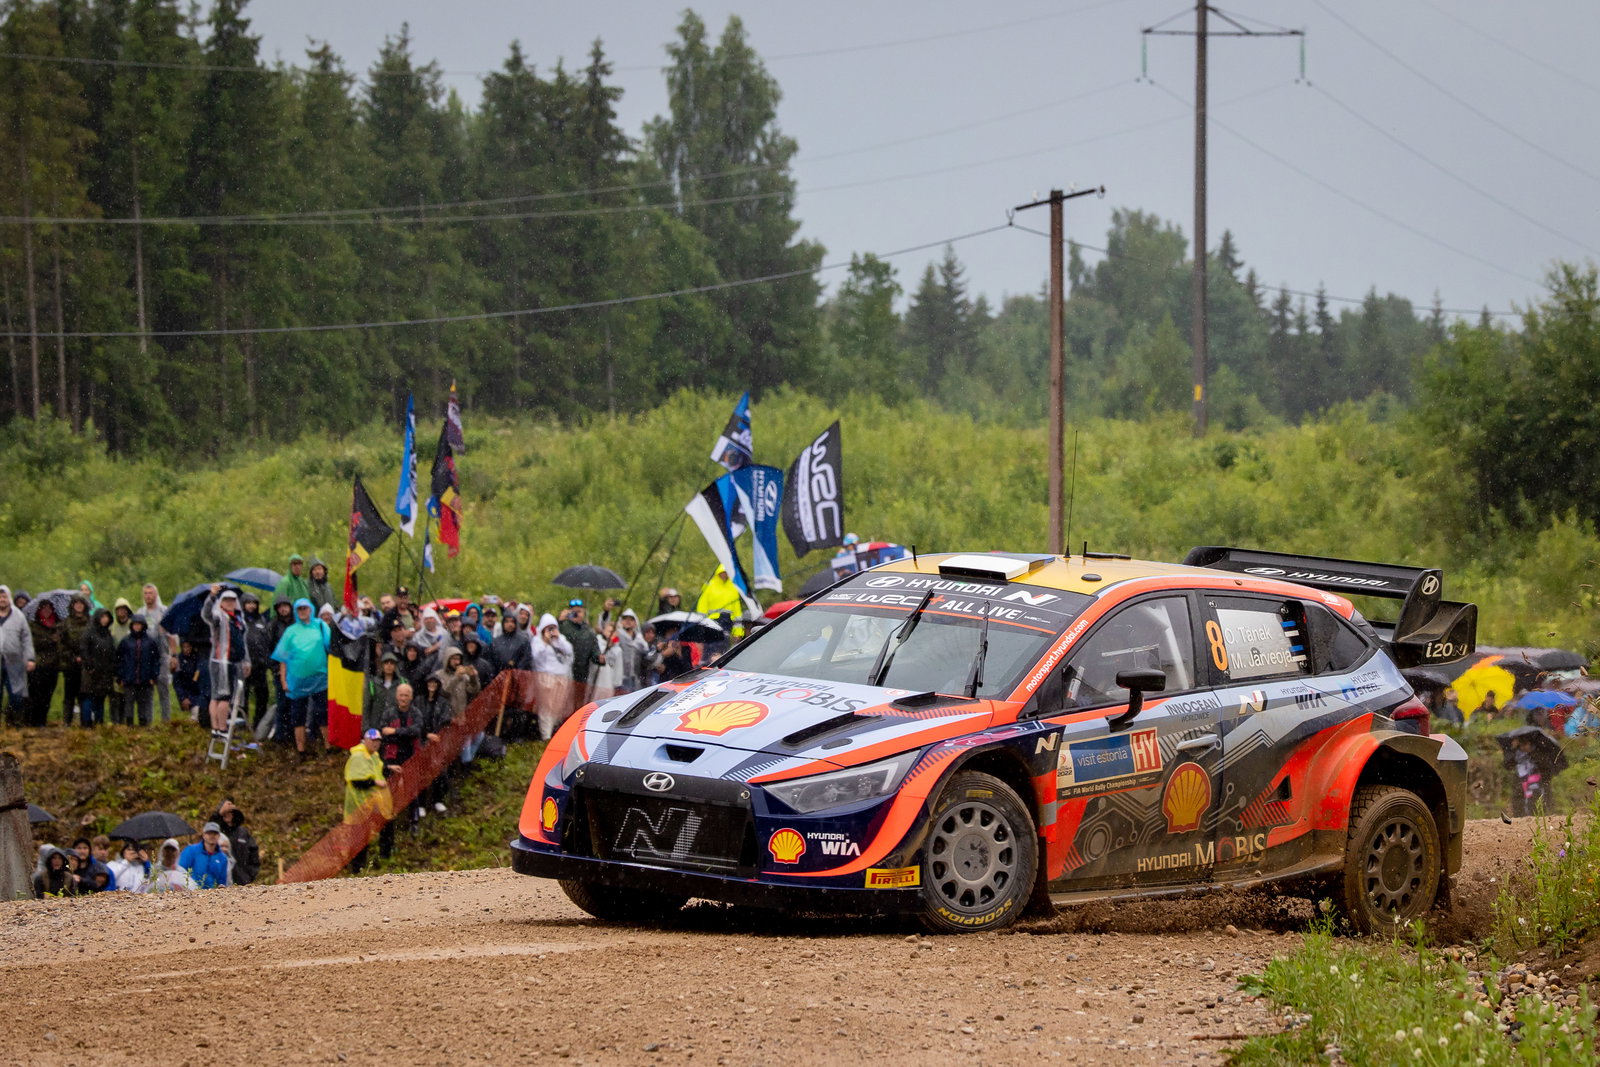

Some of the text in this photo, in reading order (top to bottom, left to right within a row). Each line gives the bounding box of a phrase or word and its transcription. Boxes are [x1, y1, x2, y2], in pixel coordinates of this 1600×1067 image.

[811, 431, 840, 540] WRC
[905, 579, 1003, 596] HYUNDAI
[1288, 571, 1389, 587] HYUNDAI
[939, 600, 974, 612] ALL
[1224, 627, 1237, 644] O.
[1205, 620, 1228, 671] 8
[1426, 642, 1453, 657] i20
[1026, 619, 1088, 692] motorsport.hyundai.com
[1230, 648, 1293, 669] M. Järveoja
[739, 677, 834, 691] HYUNDAI
[1351, 671, 1382, 684] HYUNDAI
[1280, 686, 1308, 695] HYUNDAI
[1356, 683, 1381, 695] STEEL
[741, 684, 867, 712] MOBIS
[1295, 691, 1327, 710] WIA
[1165, 698, 1219, 716] INNOCEAN
[1181, 711, 1210, 722] WORLDWIDE
[1077, 748, 1128, 767] visit estonia
[1133, 732, 1157, 770] HY
[1082, 785, 1095, 793] World
[1095, 783, 1106, 791] Rally
[1106, 779, 1137, 789] Championship
[821, 839, 860, 856] WIA
[1138, 833, 1265, 872] HYUNDAI MOBIS
[870, 870, 915, 885] PIRELLI
[937, 898, 1013, 925] SCORPION
